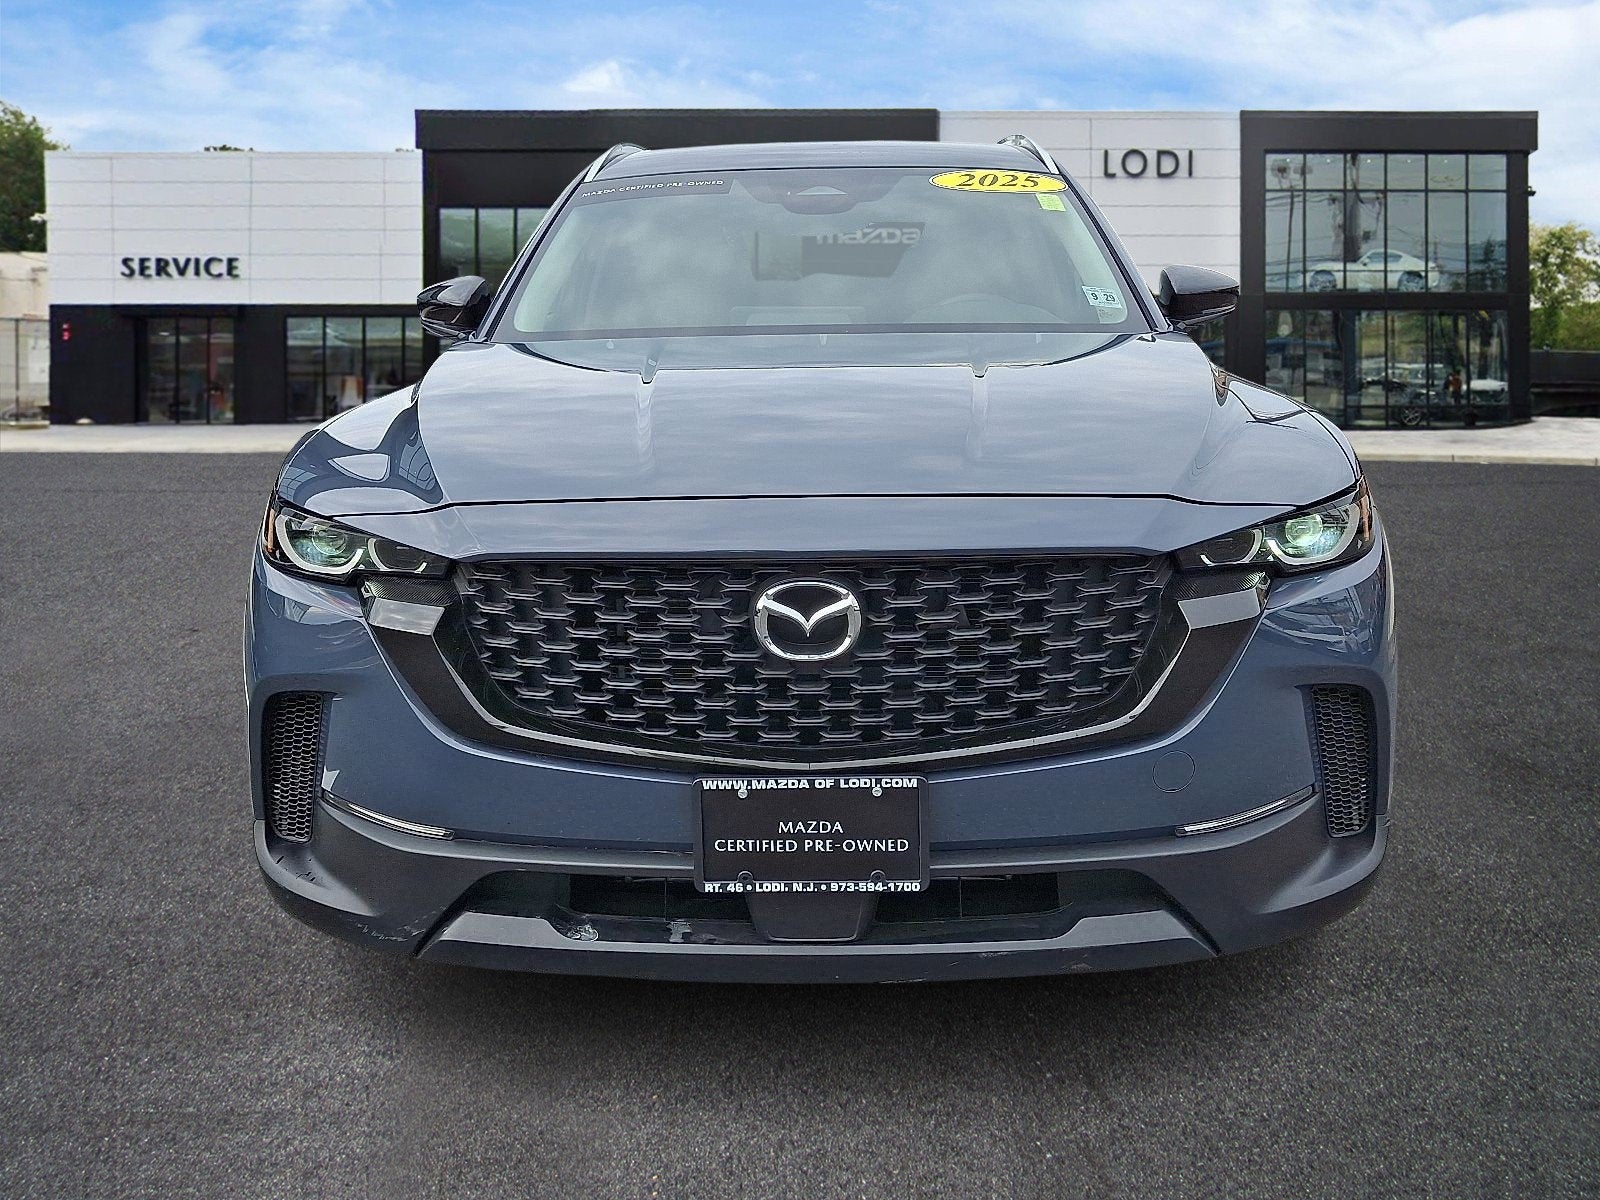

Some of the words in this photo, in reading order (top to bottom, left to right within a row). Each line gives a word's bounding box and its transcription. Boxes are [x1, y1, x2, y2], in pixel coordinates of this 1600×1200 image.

[1103, 148, 1193, 178] LODI
[956, 173, 1041, 188] 2025
[582, 188, 616, 198] MAZDA
[120, 256, 241, 279] SERVICE
[1090, 292, 1099, 301] 9
[702, 779, 810, 790] WWW.MAZDA
[815, 779, 835, 789] OF
[840, 779, 918, 789] LODI.COM
[778, 821, 844, 834] MAZDA
[714, 839, 798, 852] CERTIFIED
[804, 839, 909, 852] PRE-OWNED
[704, 882, 723, 893] RT.
[727, 882, 744, 893] 46
[793, 882, 818, 892] N.J.
[830, 882, 921, 892] 973-594-1700
